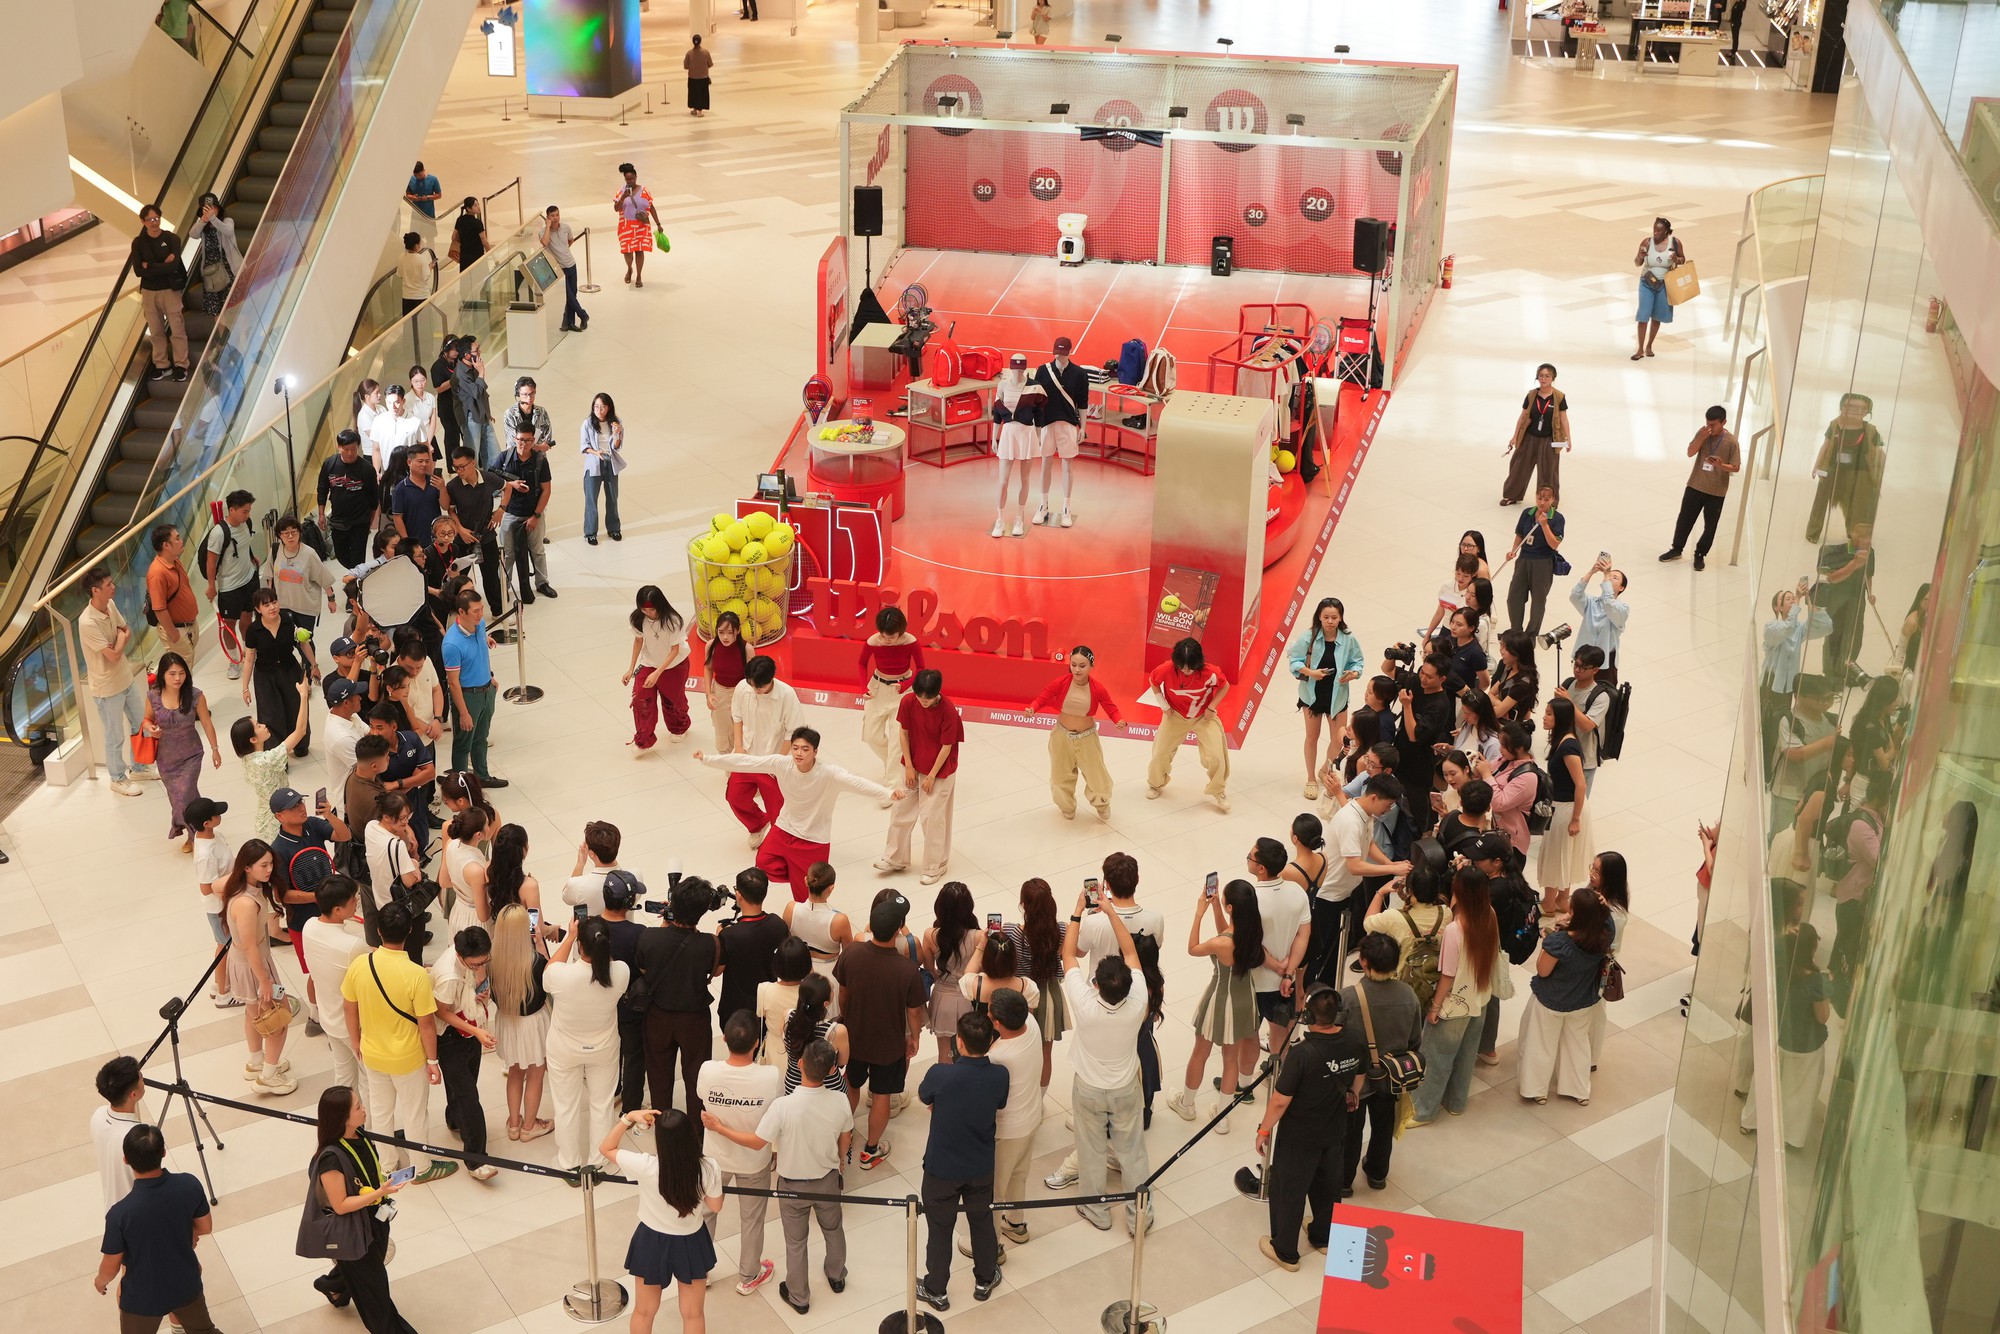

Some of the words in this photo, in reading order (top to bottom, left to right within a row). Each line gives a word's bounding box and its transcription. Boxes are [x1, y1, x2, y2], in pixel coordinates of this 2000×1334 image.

[1035, 177, 1056, 190] 20
[977, 185, 992, 195] 30
[1306, 197, 1328, 211] 20
[1248, 209, 1264, 219] 30
[1343, 336, 1365, 345] Wilson
[1157, 612, 1193, 626] WILSON
[1178, 611, 1194, 620] 100
[1155, 617, 1176, 627] TENNIS
[1175, 622, 1190, 630] BALL
[990, 712, 1012, 721] MIND
[1036, 716, 1058, 726] STEP
[1128, 726, 1149, 736] MIND
[709, 1090, 724, 1098] FILA
[708, 1096, 764, 1106] ORIGINALE
